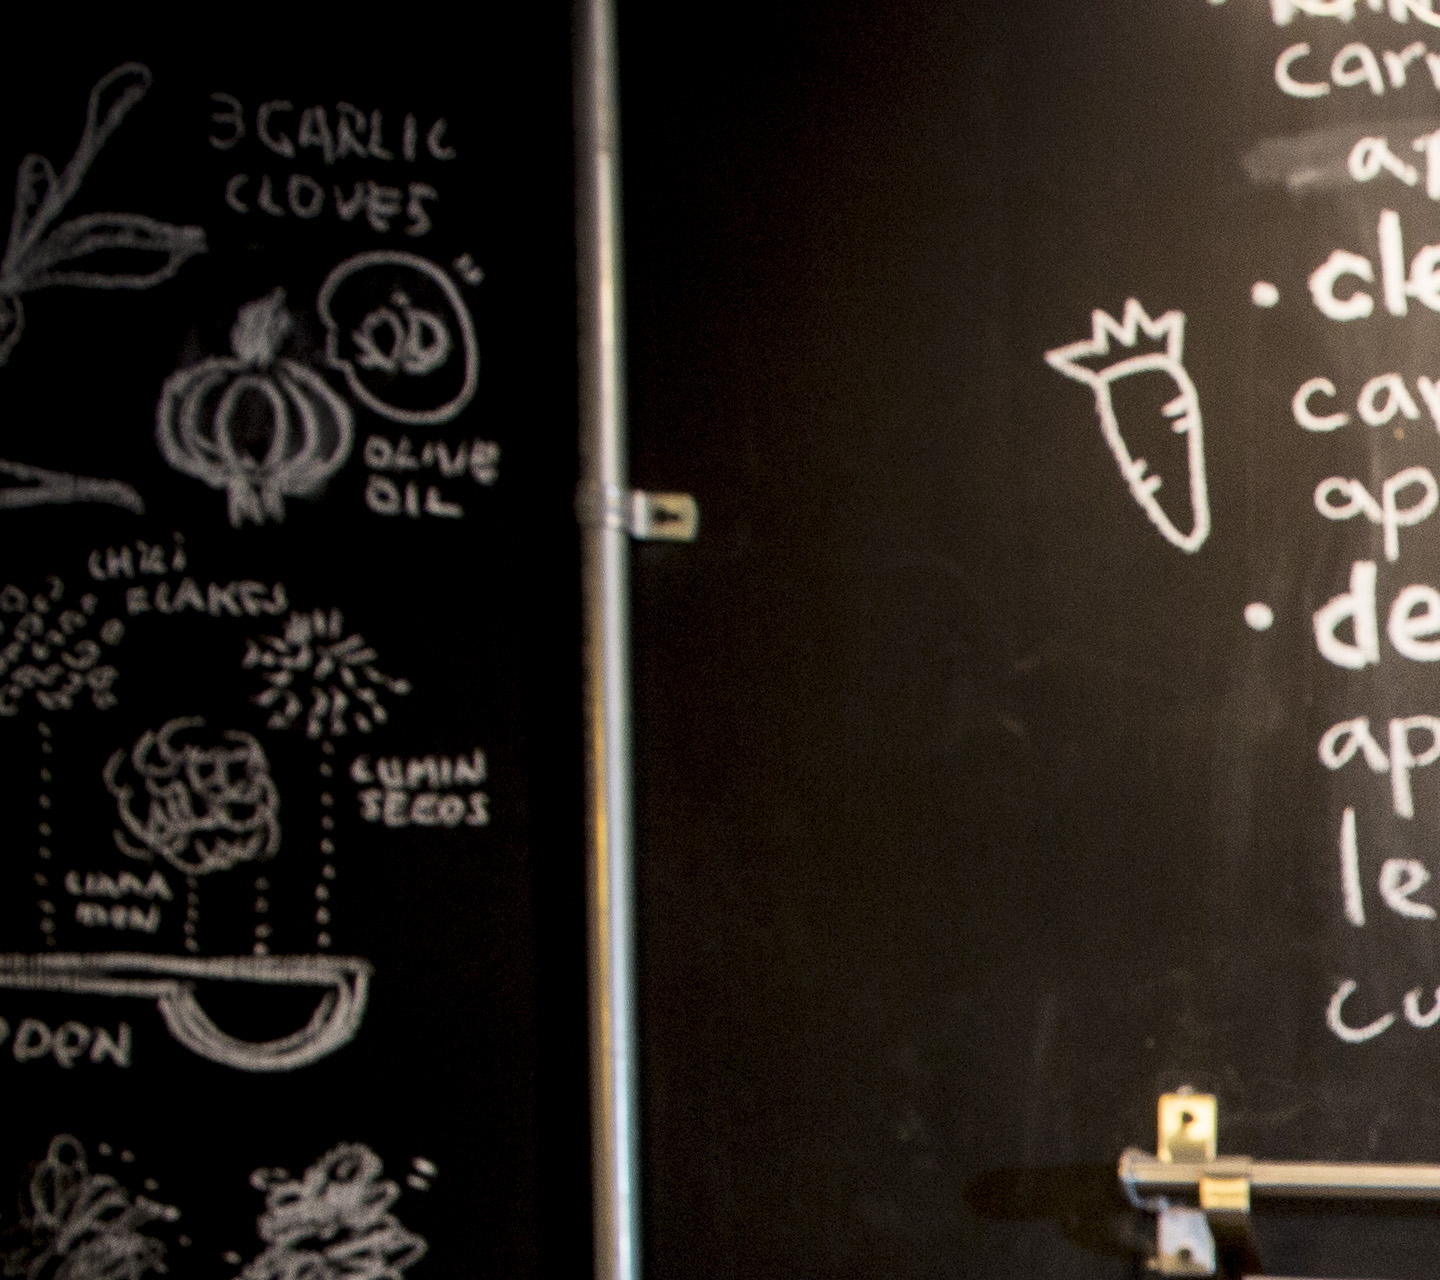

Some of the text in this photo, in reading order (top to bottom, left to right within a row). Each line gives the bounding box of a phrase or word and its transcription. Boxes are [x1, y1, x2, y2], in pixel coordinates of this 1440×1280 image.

[224, 173, 439, 238] CLOVES
[364, 473, 466, 520] OIL
[348, 745, 488, 790] CUMIN
